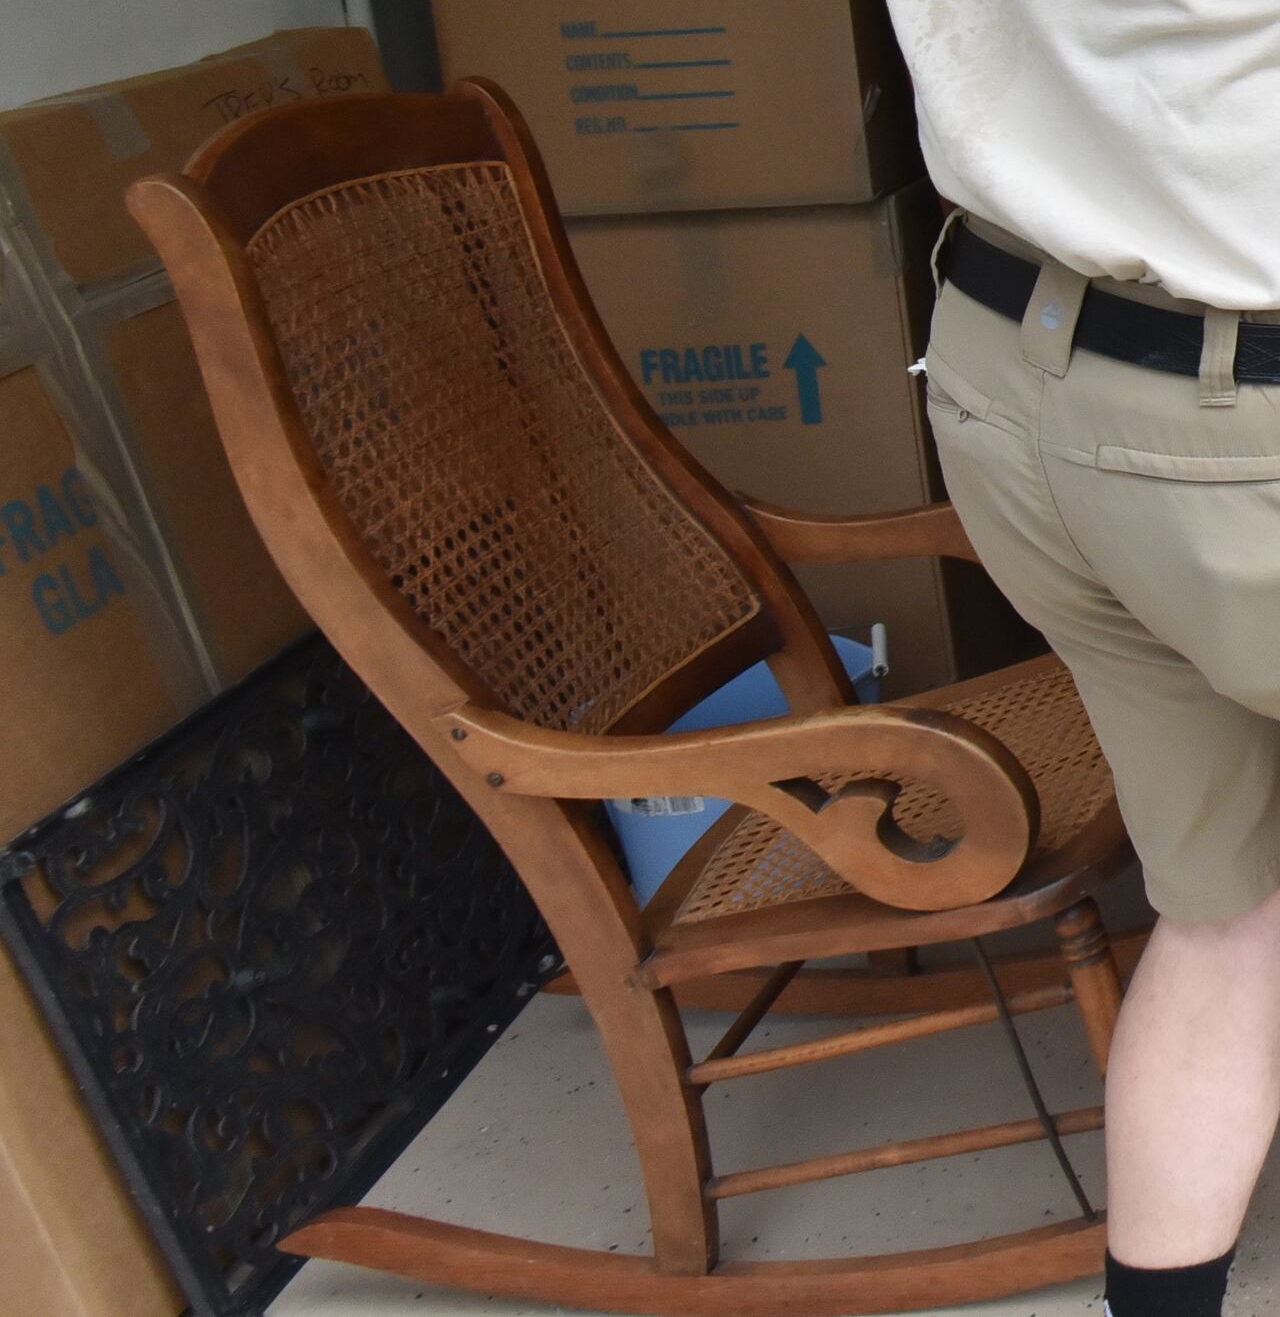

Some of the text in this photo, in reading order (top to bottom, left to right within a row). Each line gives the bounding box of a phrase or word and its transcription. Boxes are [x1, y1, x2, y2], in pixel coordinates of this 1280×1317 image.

[640, 343, 770, 386] FRAGILE
[658, 386, 761, 405] THIS SIDE UP
[659, 405, 787, 428] NDLE WITH CARE
